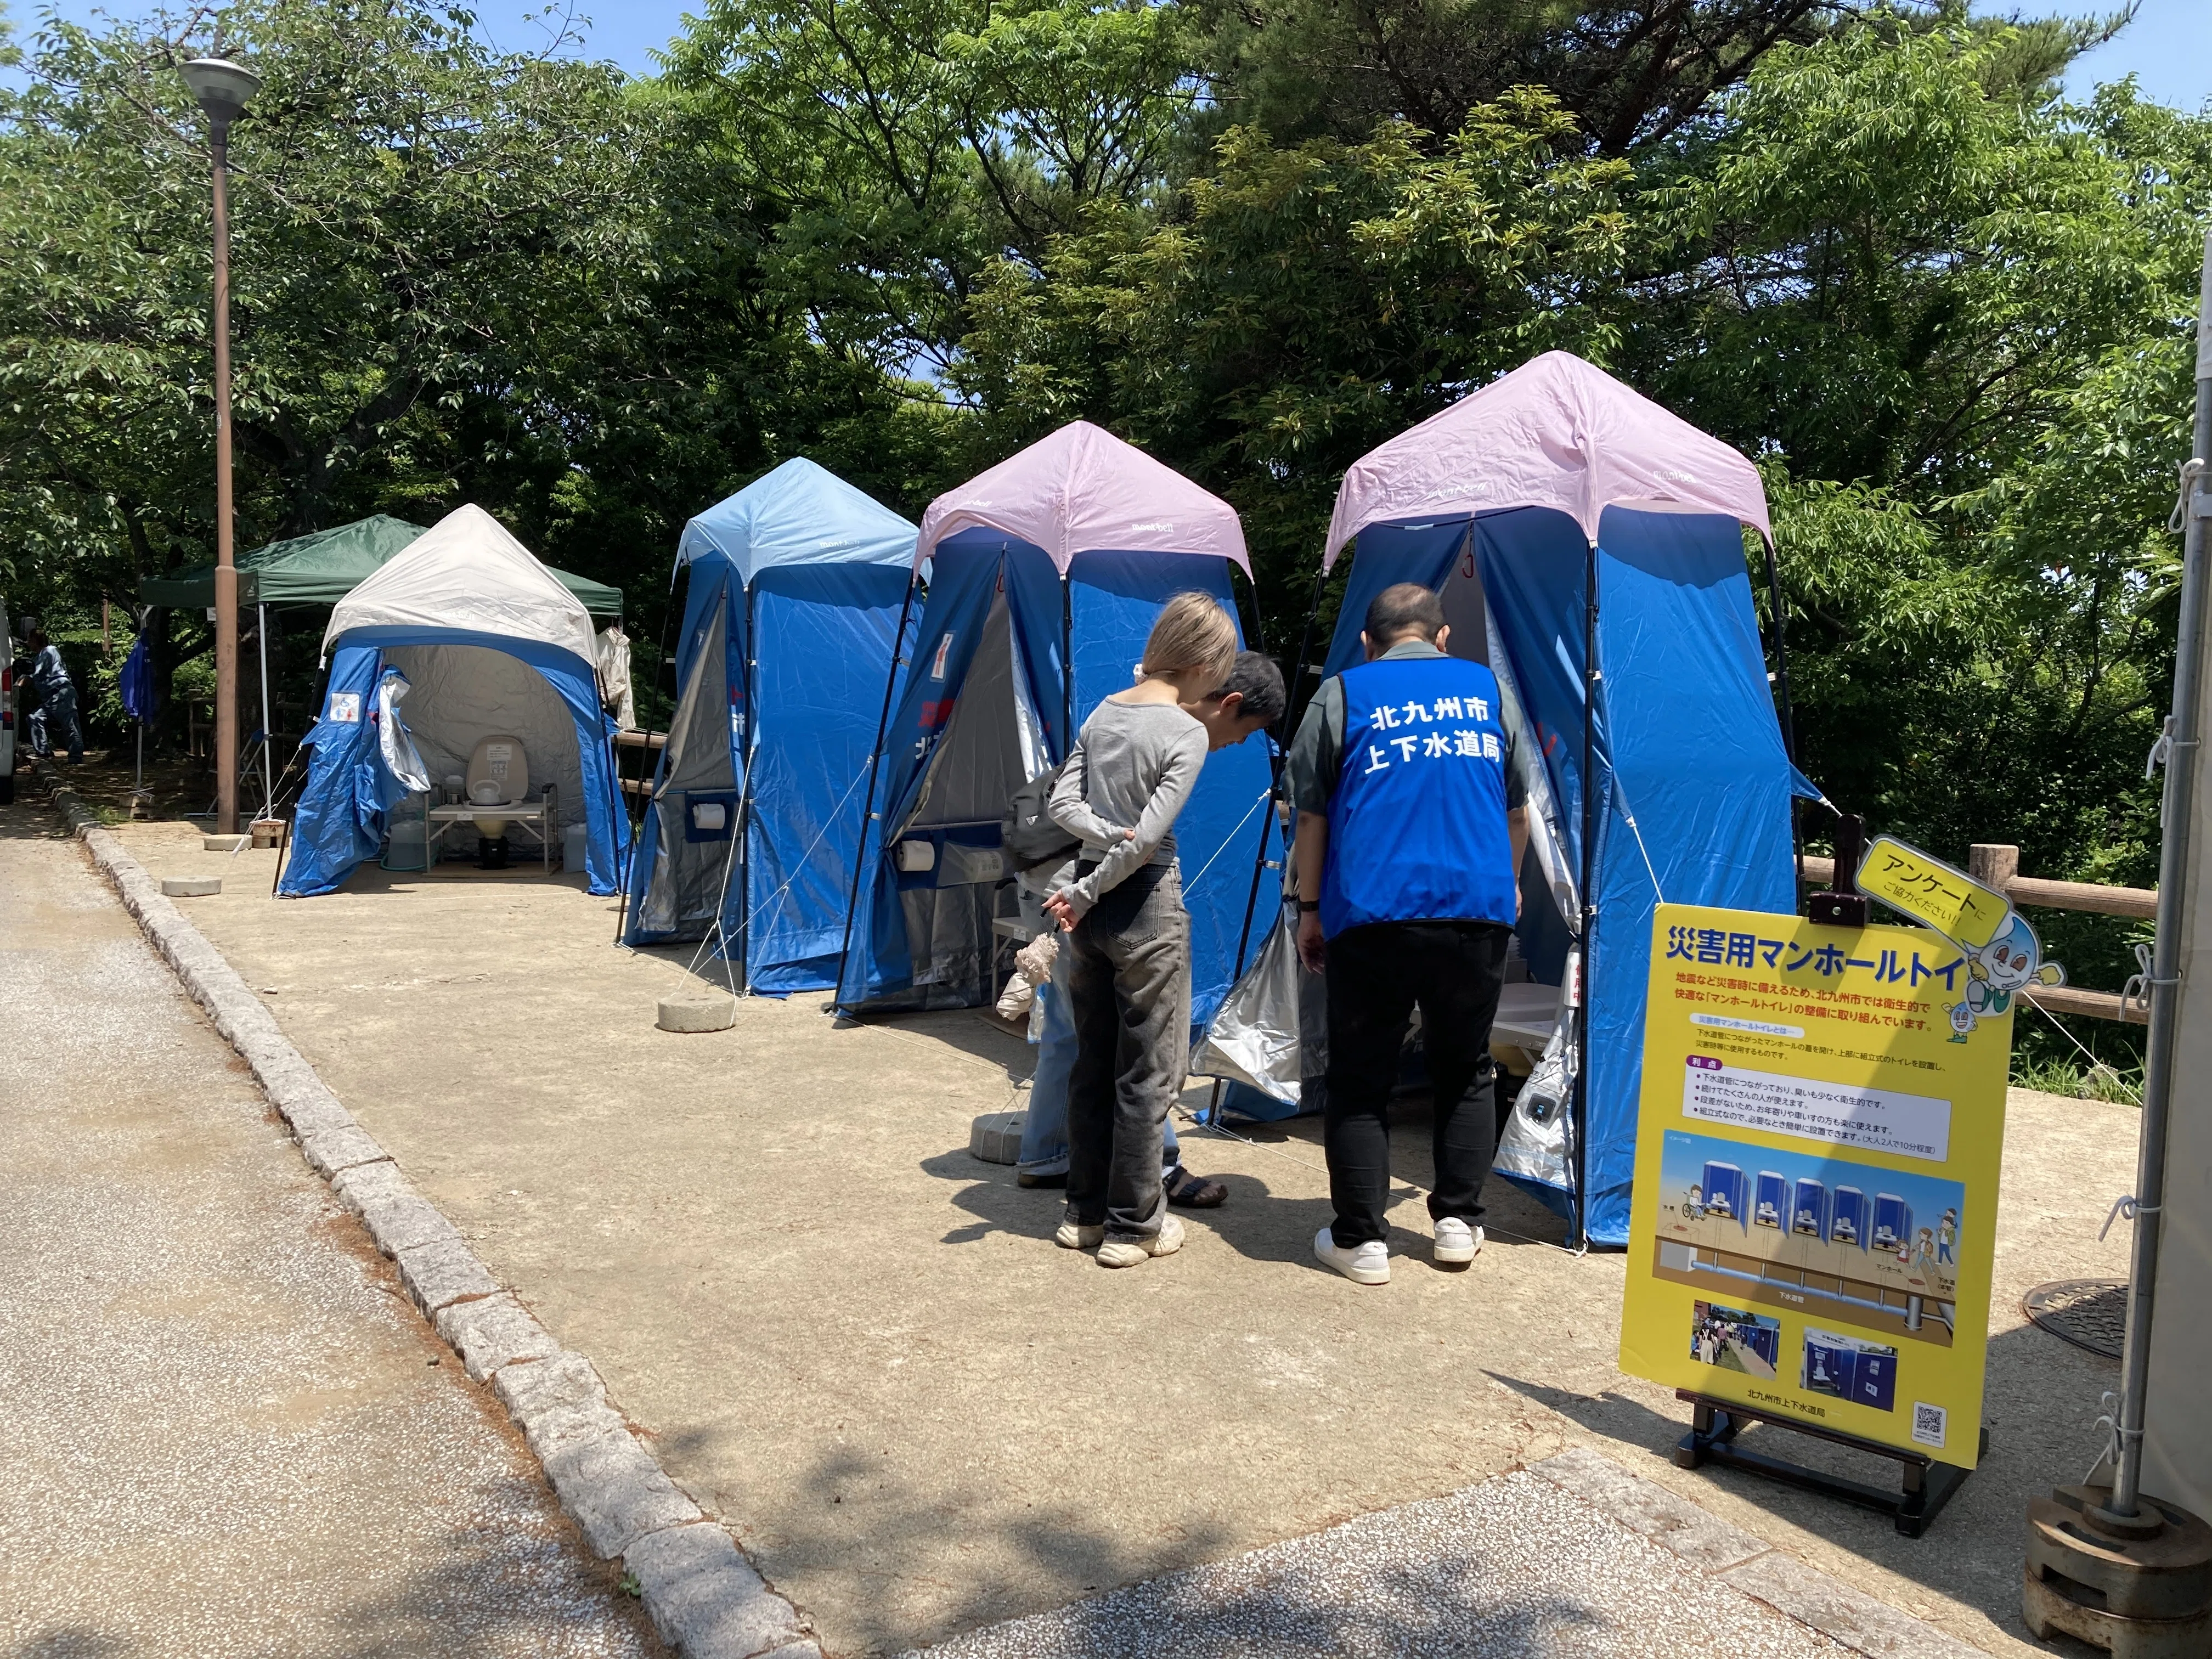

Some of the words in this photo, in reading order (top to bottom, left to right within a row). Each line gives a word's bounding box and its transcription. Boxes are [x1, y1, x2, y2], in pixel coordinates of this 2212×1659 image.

[1370, 696, 1488, 730] 北九州市
[1364, 730, 1500, 774] 上下水道局
[1883, 854, 1986, 921] アンケートに
[1666, 925, 1966, 991] 災害用マンホールトイ
[1675, 972, 1931, 1013] 地震など災害時に備えるため、北九州市では衛生的で
[1876, 1263, 1902, 1273] マンホール
[1747, 1389, 1826, 1418] 北九州市上下水道局
